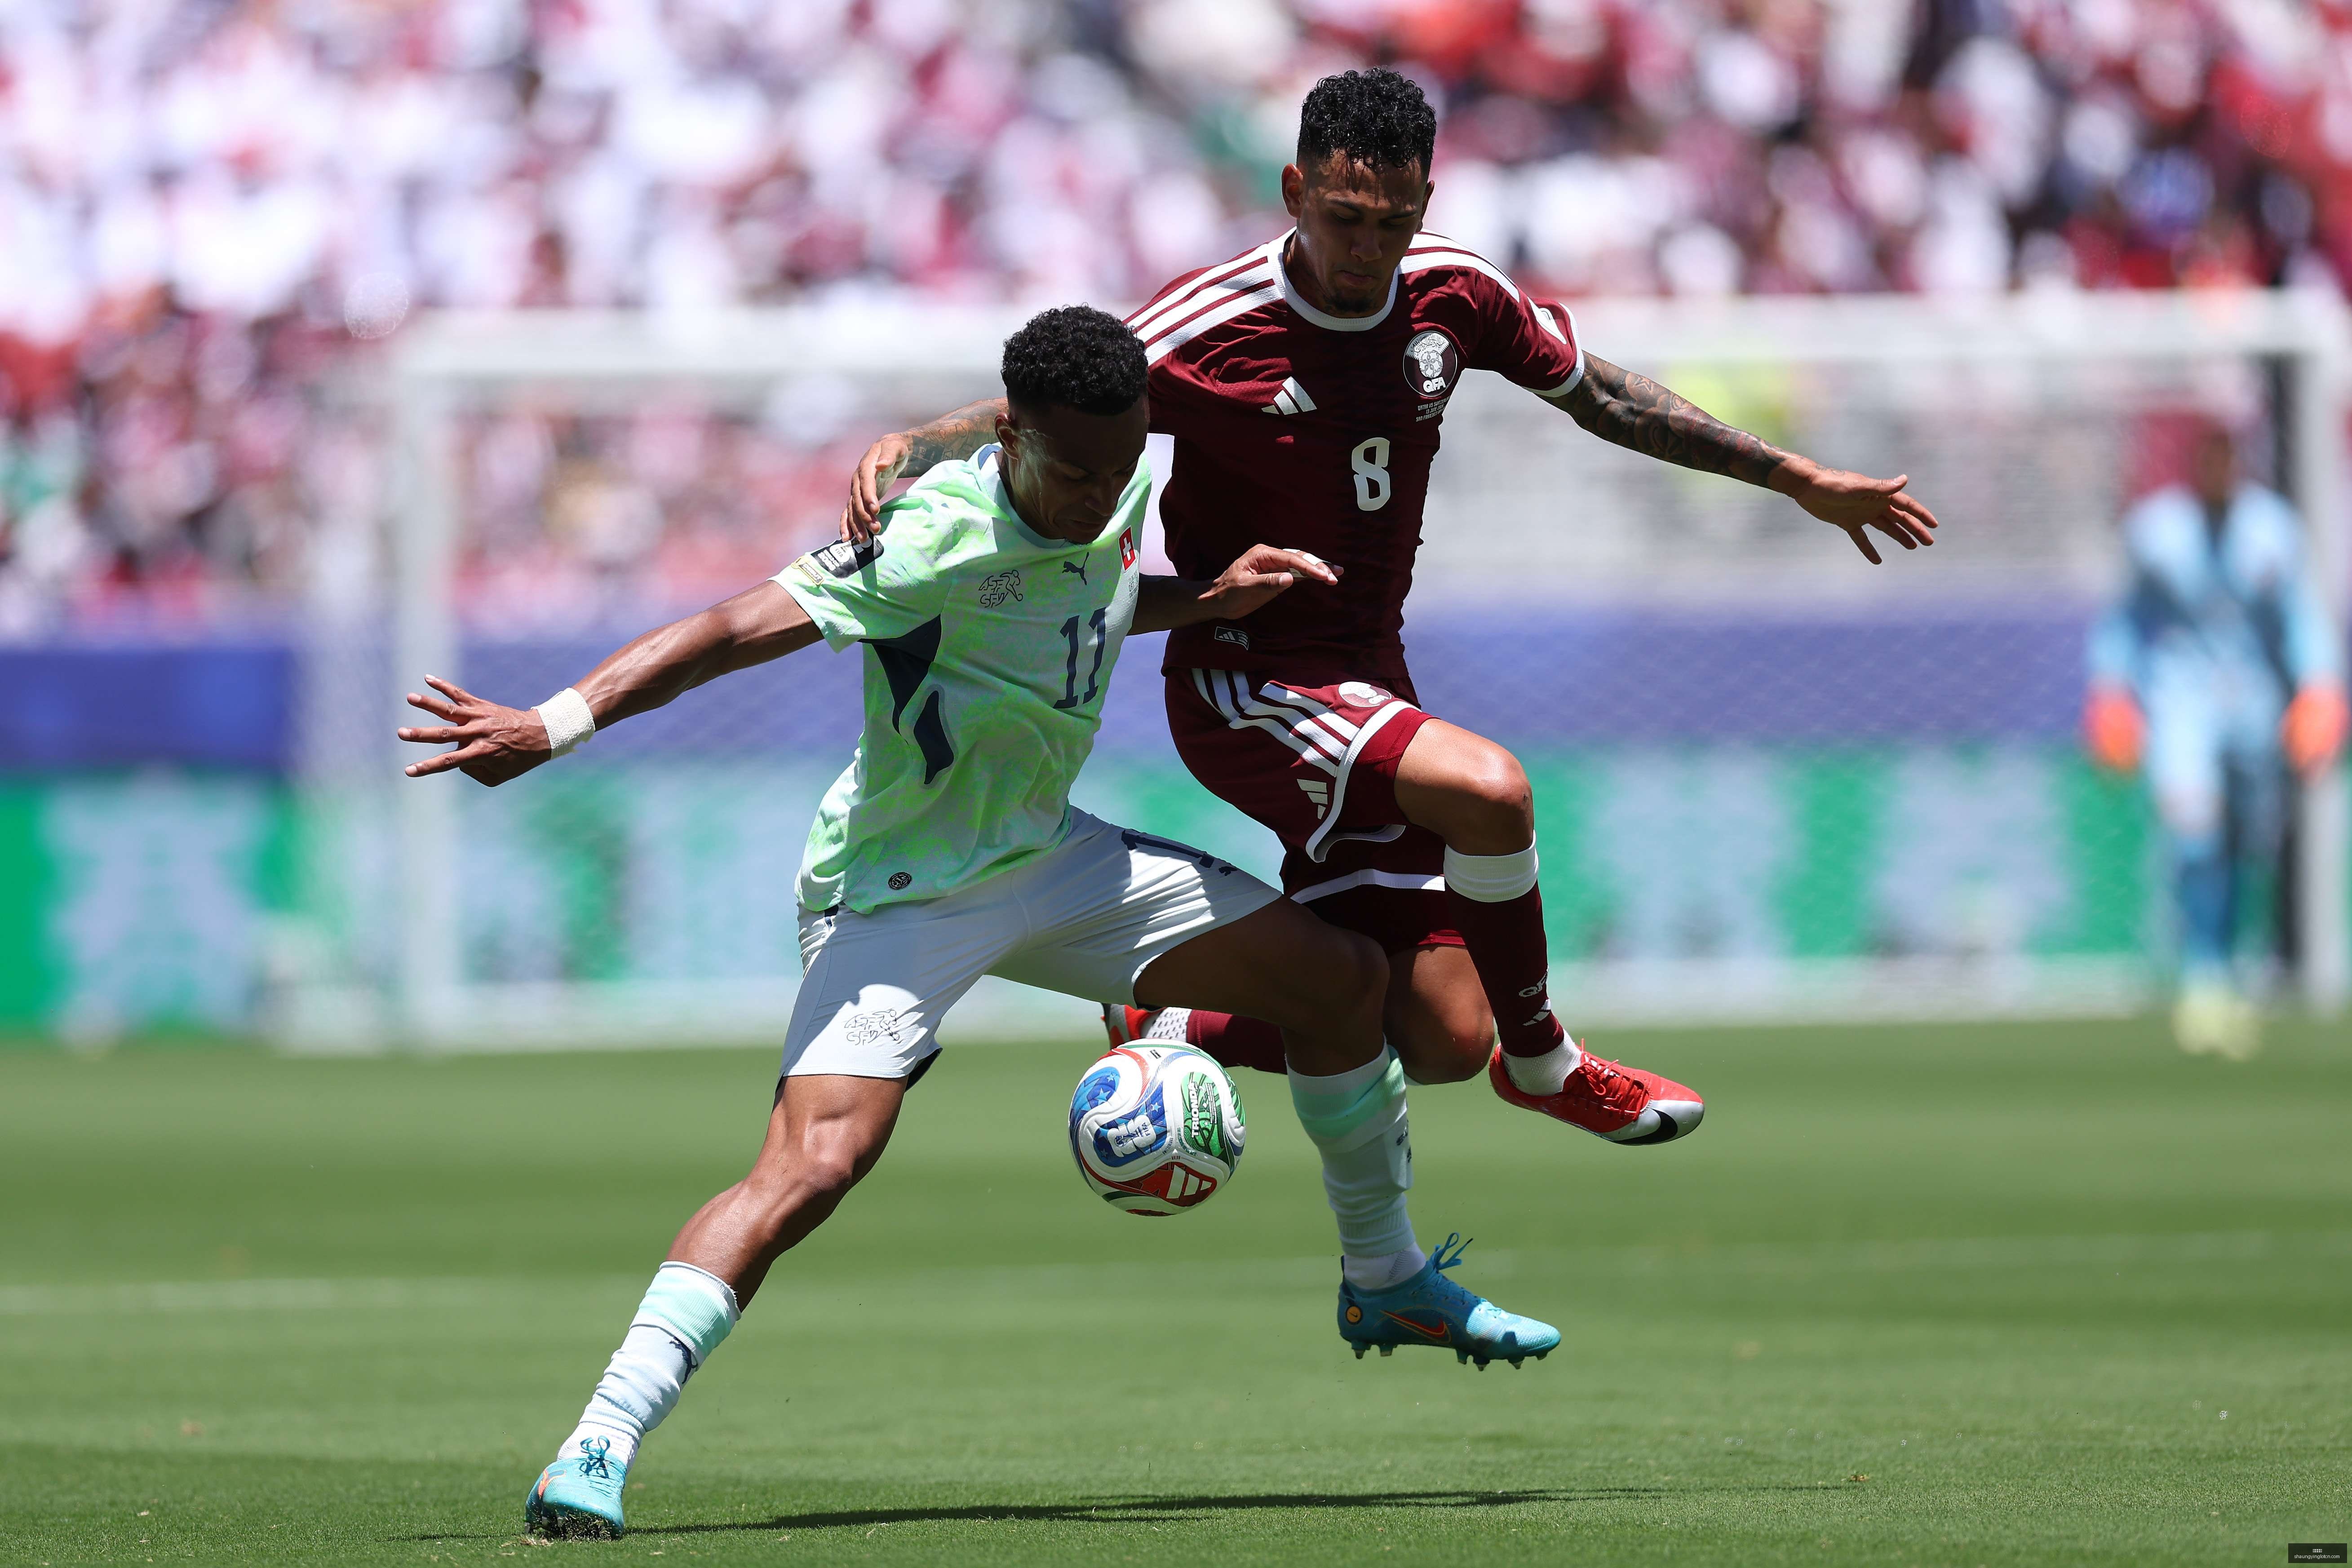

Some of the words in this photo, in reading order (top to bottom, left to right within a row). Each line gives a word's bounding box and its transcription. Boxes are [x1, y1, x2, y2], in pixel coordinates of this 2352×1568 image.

[1423, 376, 1446, 393] QFA
[1351, 437, 1391, 511] 8
[835, 548, 843, 558] FIFA
[1053, 607, 1106, 709] 11
[1188, 1082, 1199, 1138] TRIONDA
[1142, 1122, 1150, 1136] FIFA
